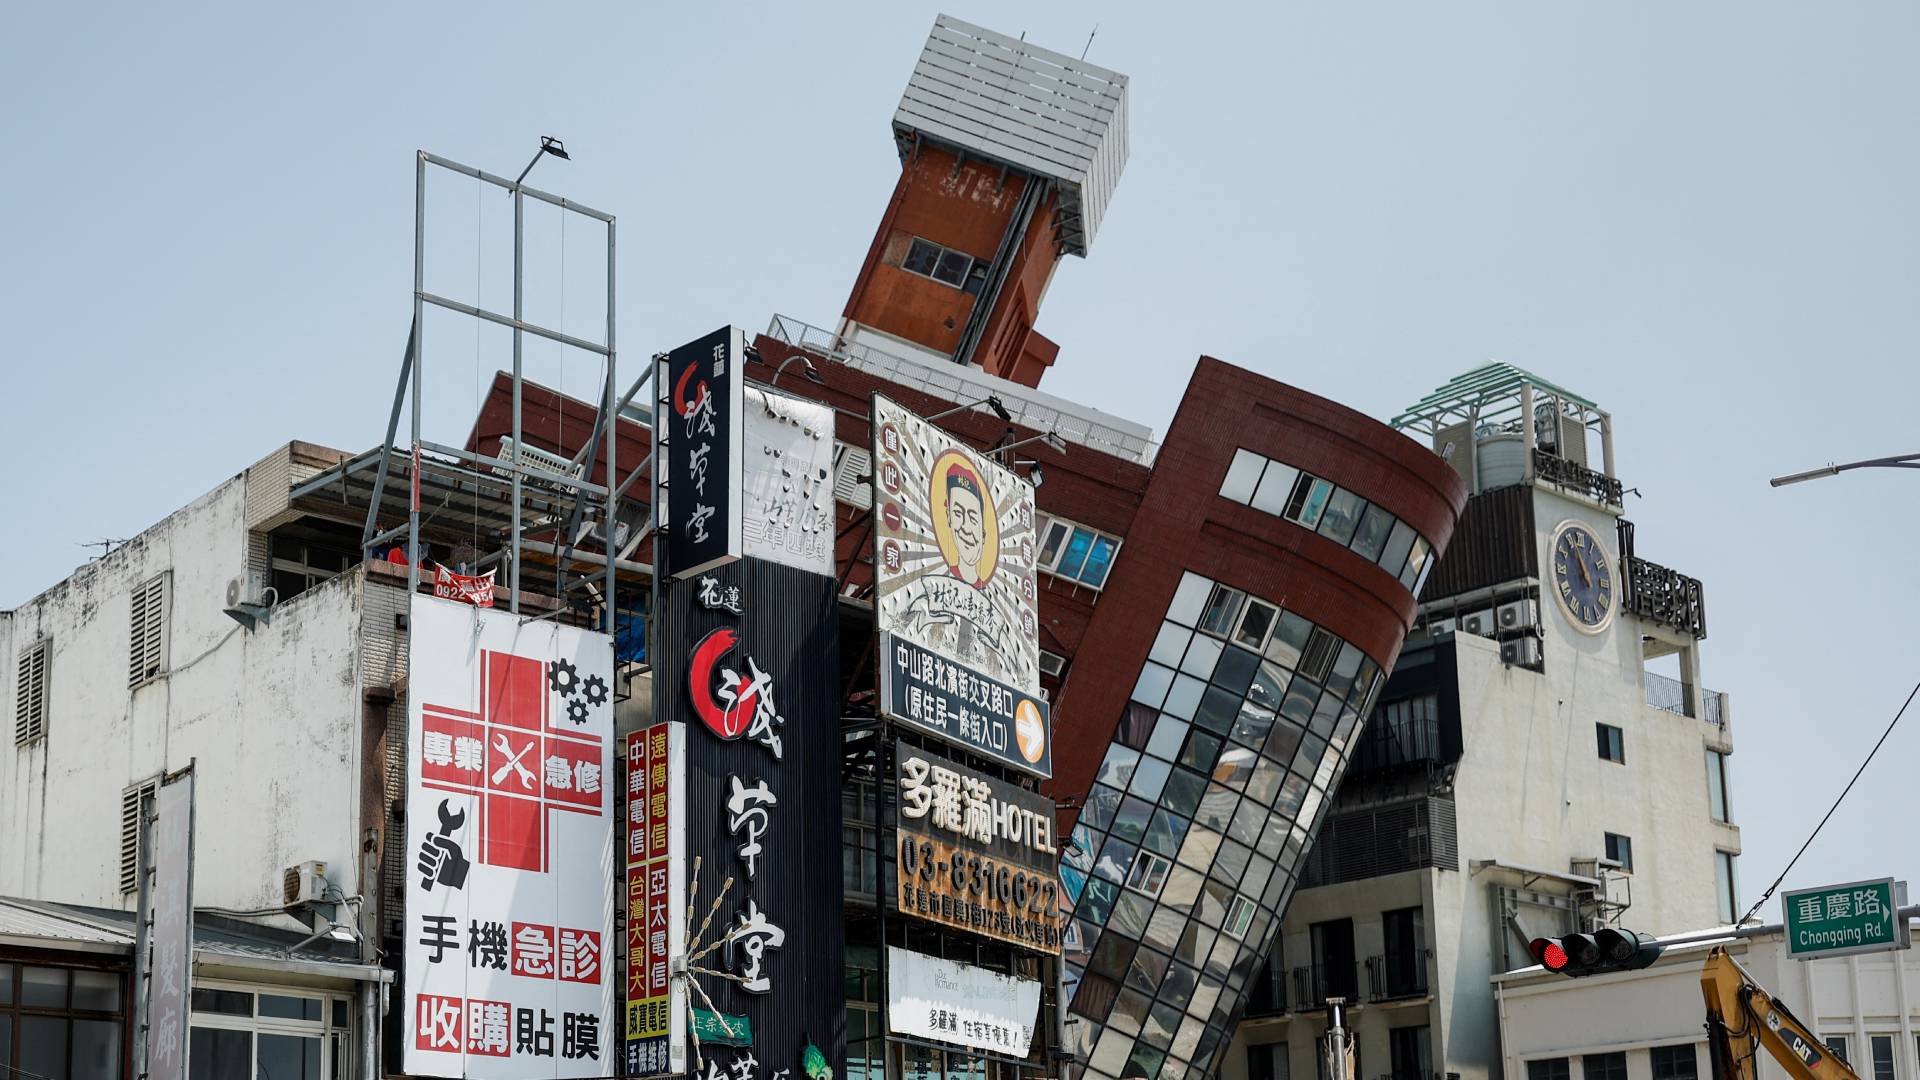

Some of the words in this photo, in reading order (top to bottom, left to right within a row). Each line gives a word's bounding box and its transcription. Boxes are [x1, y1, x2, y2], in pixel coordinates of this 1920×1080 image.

[437, 583, 466, 600] 0922
[701, 576, 743, 612] 花蓮
[896, 643, 1014, 719] 中山路北濱街交叉路口
[905, 684, 1008, 753] (原住民一條街入口)
[423, 730, 483, 772] 專業
[544, 755, 601, 794] 急修
[650, 732, 667, 851] 遠傳電信
[629, 740, 645, 856] 中華電信
[901, 757, 992, 845] 多羅滿
[991, 797, 1057, 855] HOTEL
[902, 836, 1058, 918] 03-8316622
[1797, 889, 1881, 924] 重慶路
[420, 915, 600, 980] 手機急診
[629, 875, 645, 993] 台灣大哥大
[650, 868, 667, 990] 亞太電信
[1800, 925, 1861, 947] Chongqing
[1865, 922, 1885, 938] Rd.
[419, 997, 600, 1061] 收購貼膜
[628, 1040, 668, 1075] 手機維修
[1793, 1037, 1811, 1062] CAT
